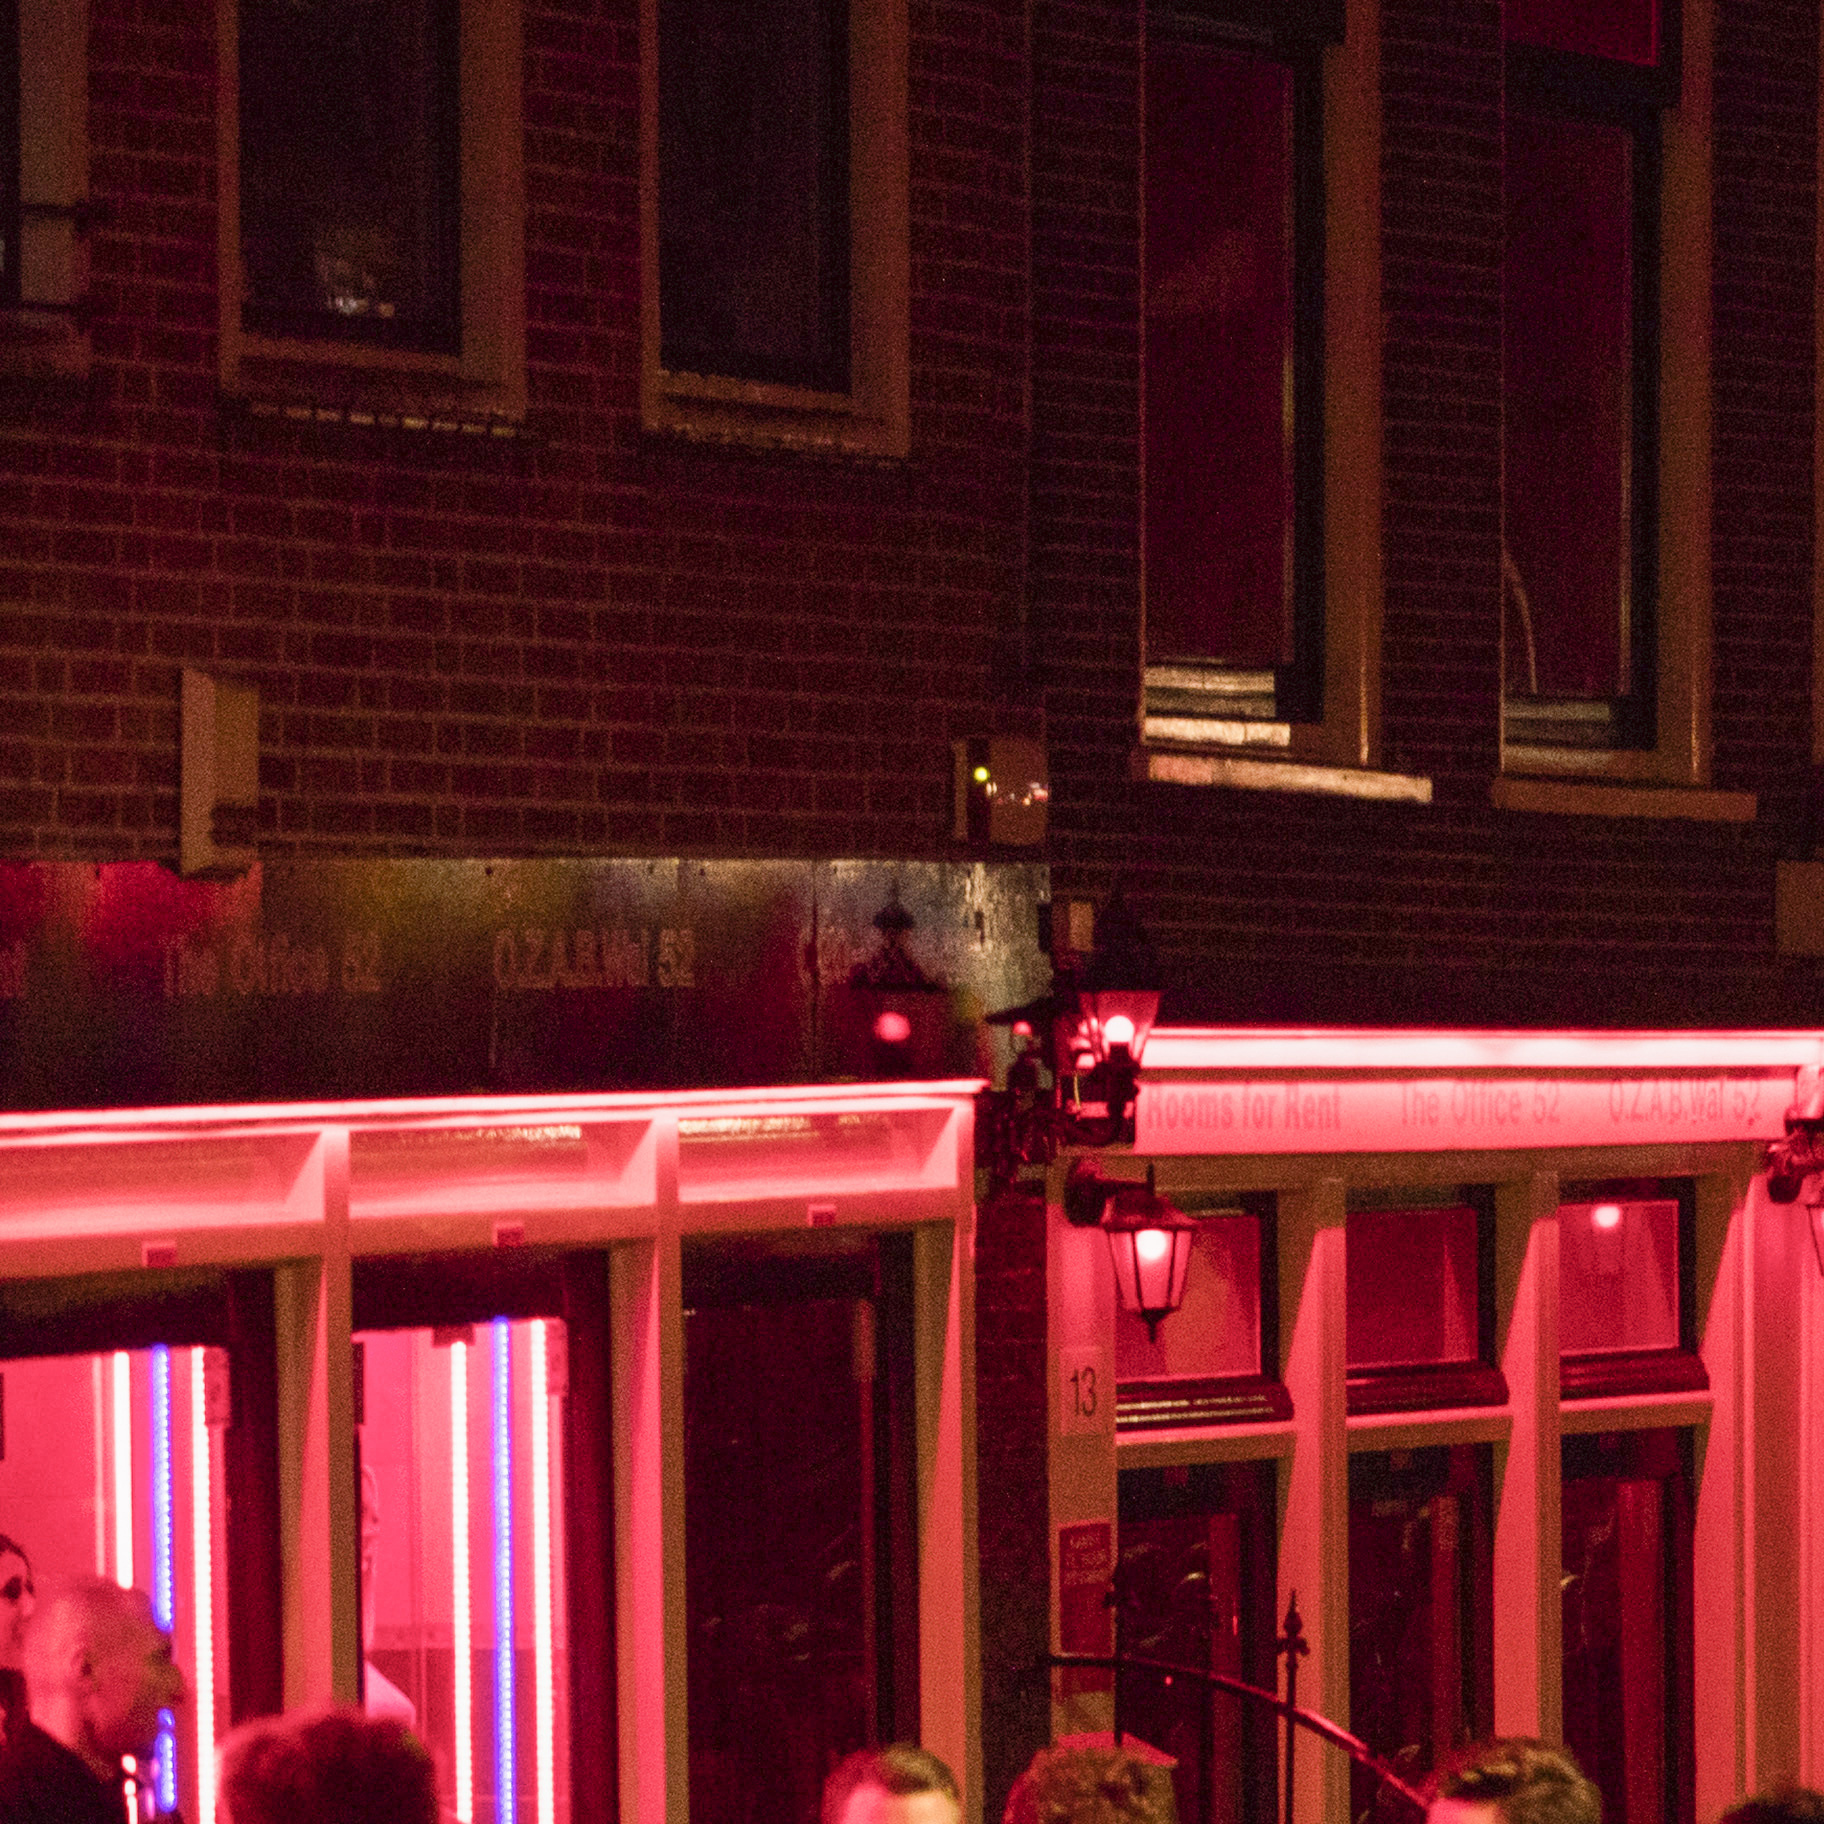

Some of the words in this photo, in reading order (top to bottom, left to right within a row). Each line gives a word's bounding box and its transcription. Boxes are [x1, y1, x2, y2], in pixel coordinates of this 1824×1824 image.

[1147, 1084, 1235, 1130] Rooms
[1241, 1082, 1274, 1130] for
[1284, 1081, 1341, 1130] Rent
[1400, 1079, 1440, 1127] The
[1450, 1078, 1522, 1126] Office
[1533, 1078, 1562, 1124] 52
[1069, 1366, 1097, 1418] 13
